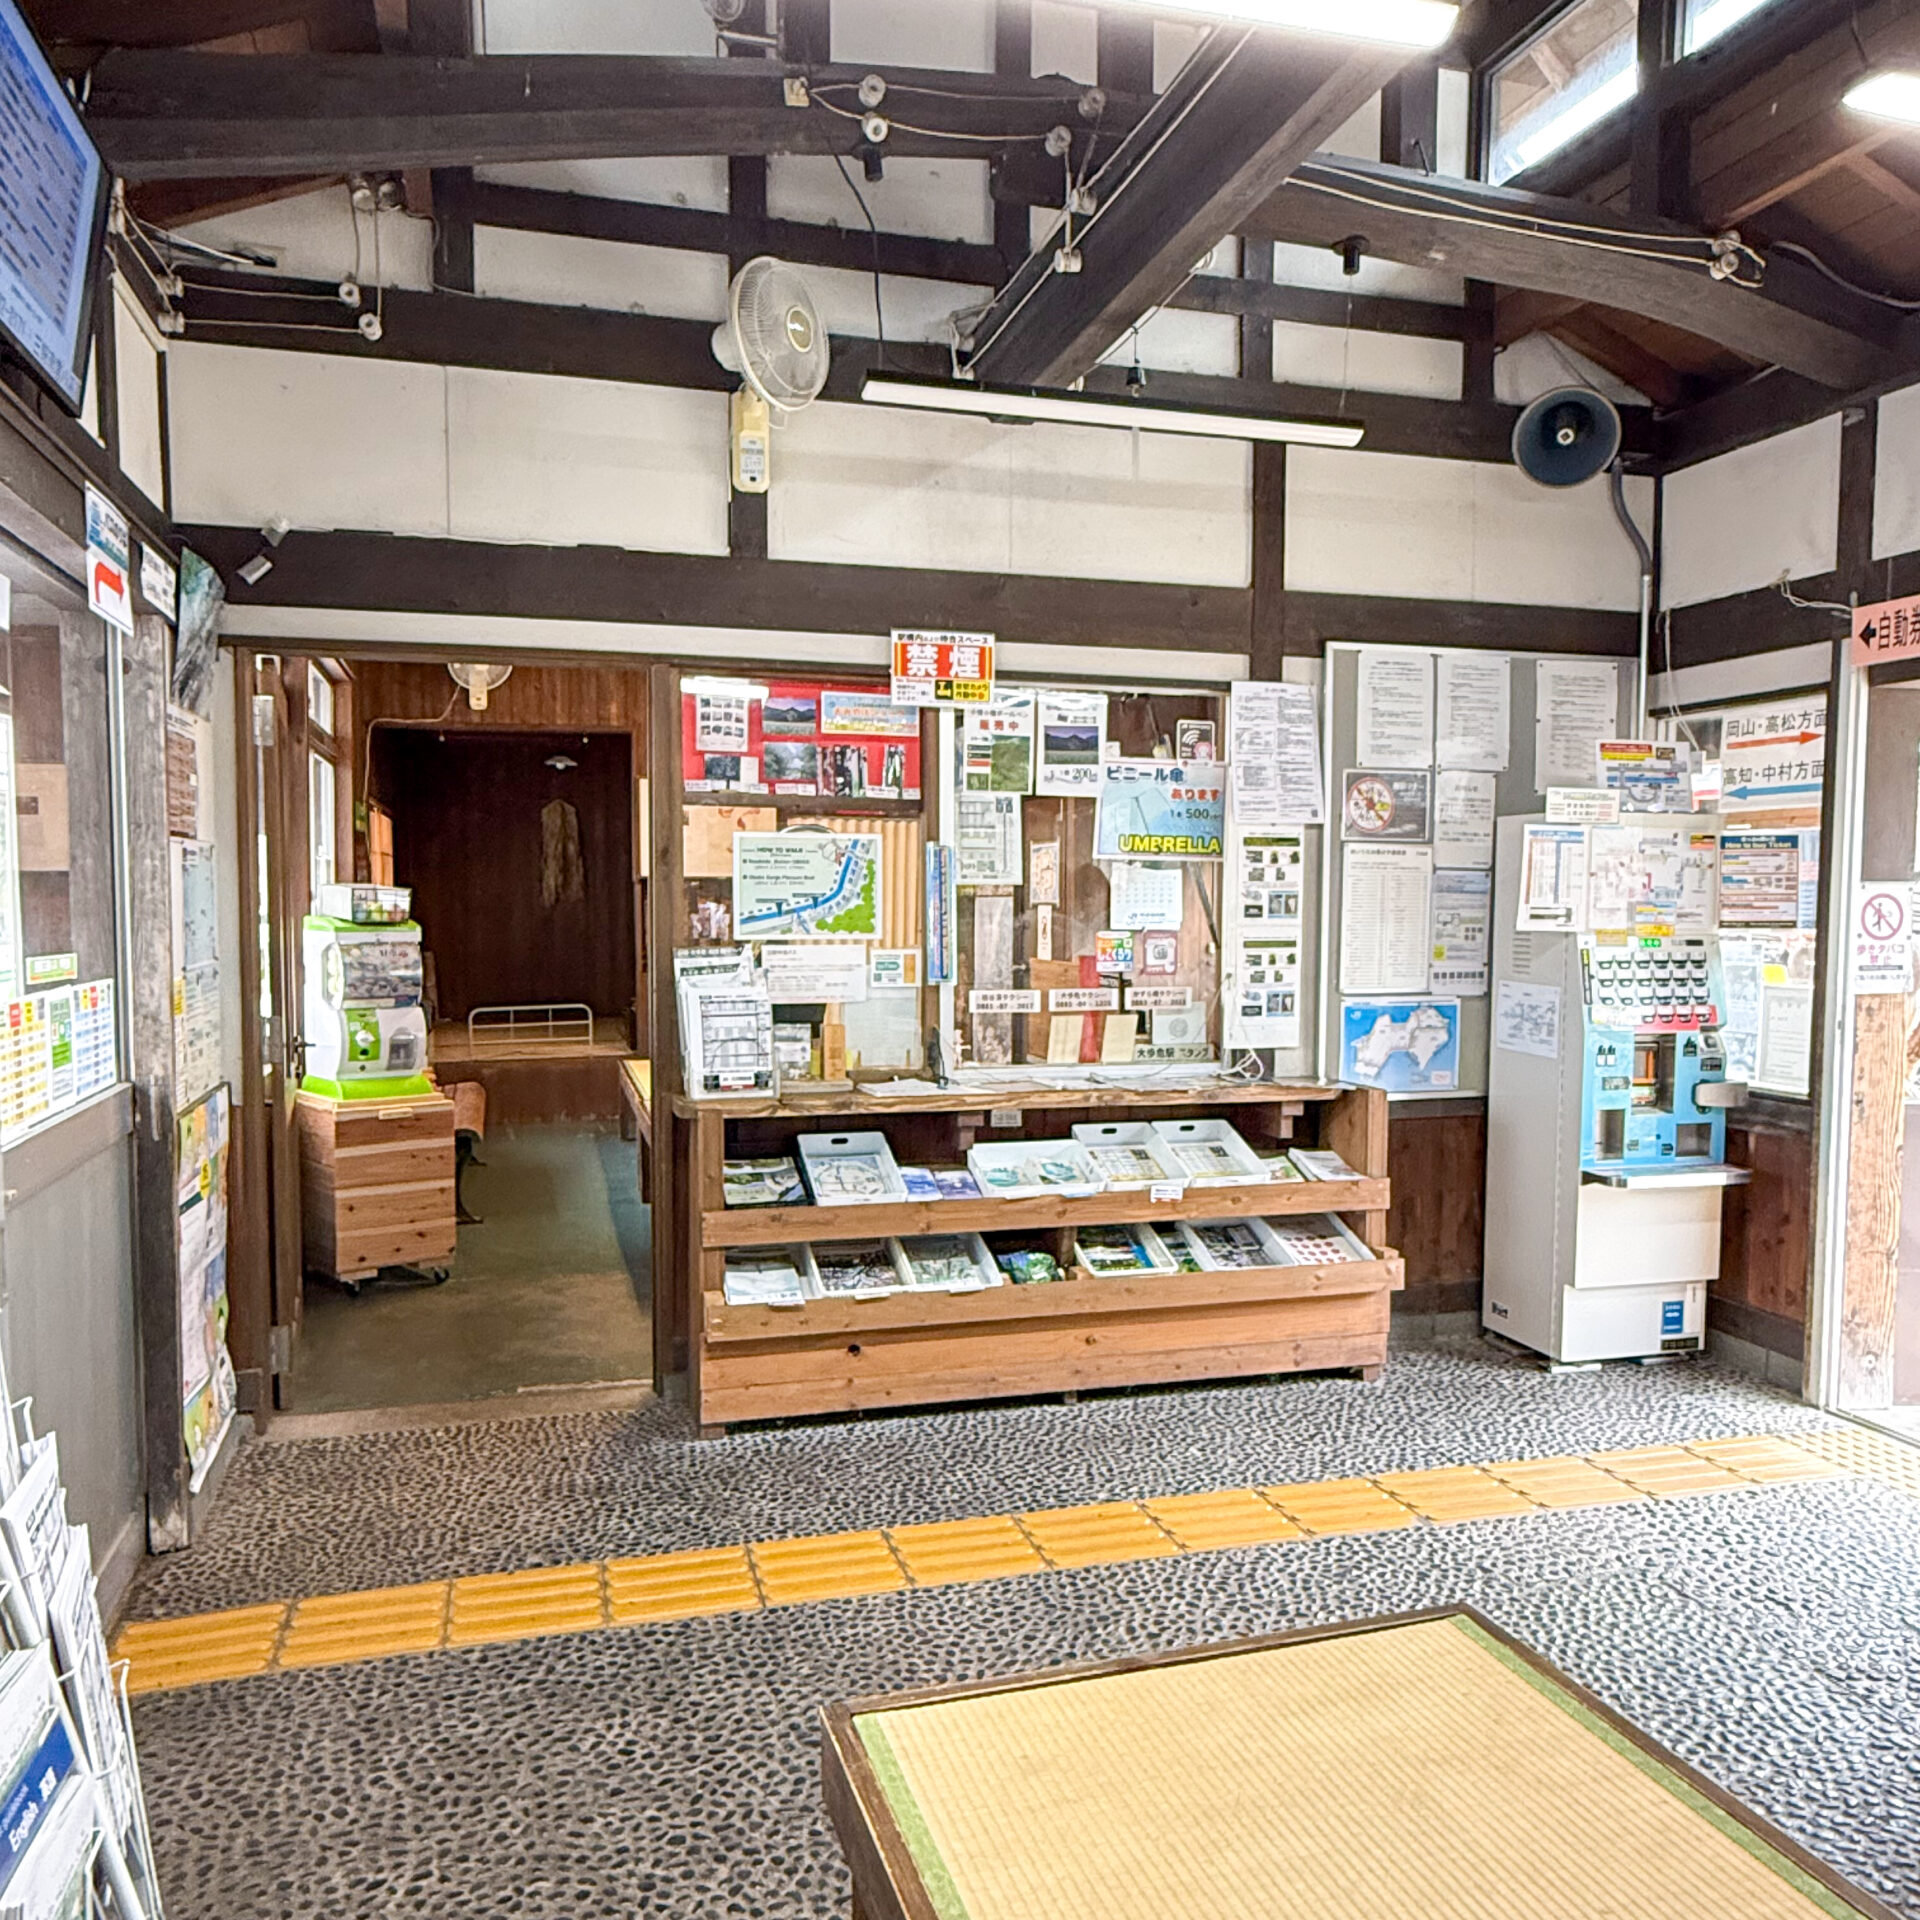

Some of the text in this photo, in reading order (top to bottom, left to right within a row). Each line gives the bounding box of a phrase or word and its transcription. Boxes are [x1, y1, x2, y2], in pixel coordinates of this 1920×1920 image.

[906, 644, 981, 678] 禁煙
[1725, 708, 1827, 738] 岡山・高松方面
[1107, 766, 1184, 782] ビニール傘
[1723, 760, 1824, 786] 高知・中村方面
[1171, 788, 1220, 802] あります
[1119, 834, 1220, 855] UMBRELLA
[1857, 944, 1905, 955] 歩きタバコ
[8, 1801, 39, 1852] English
